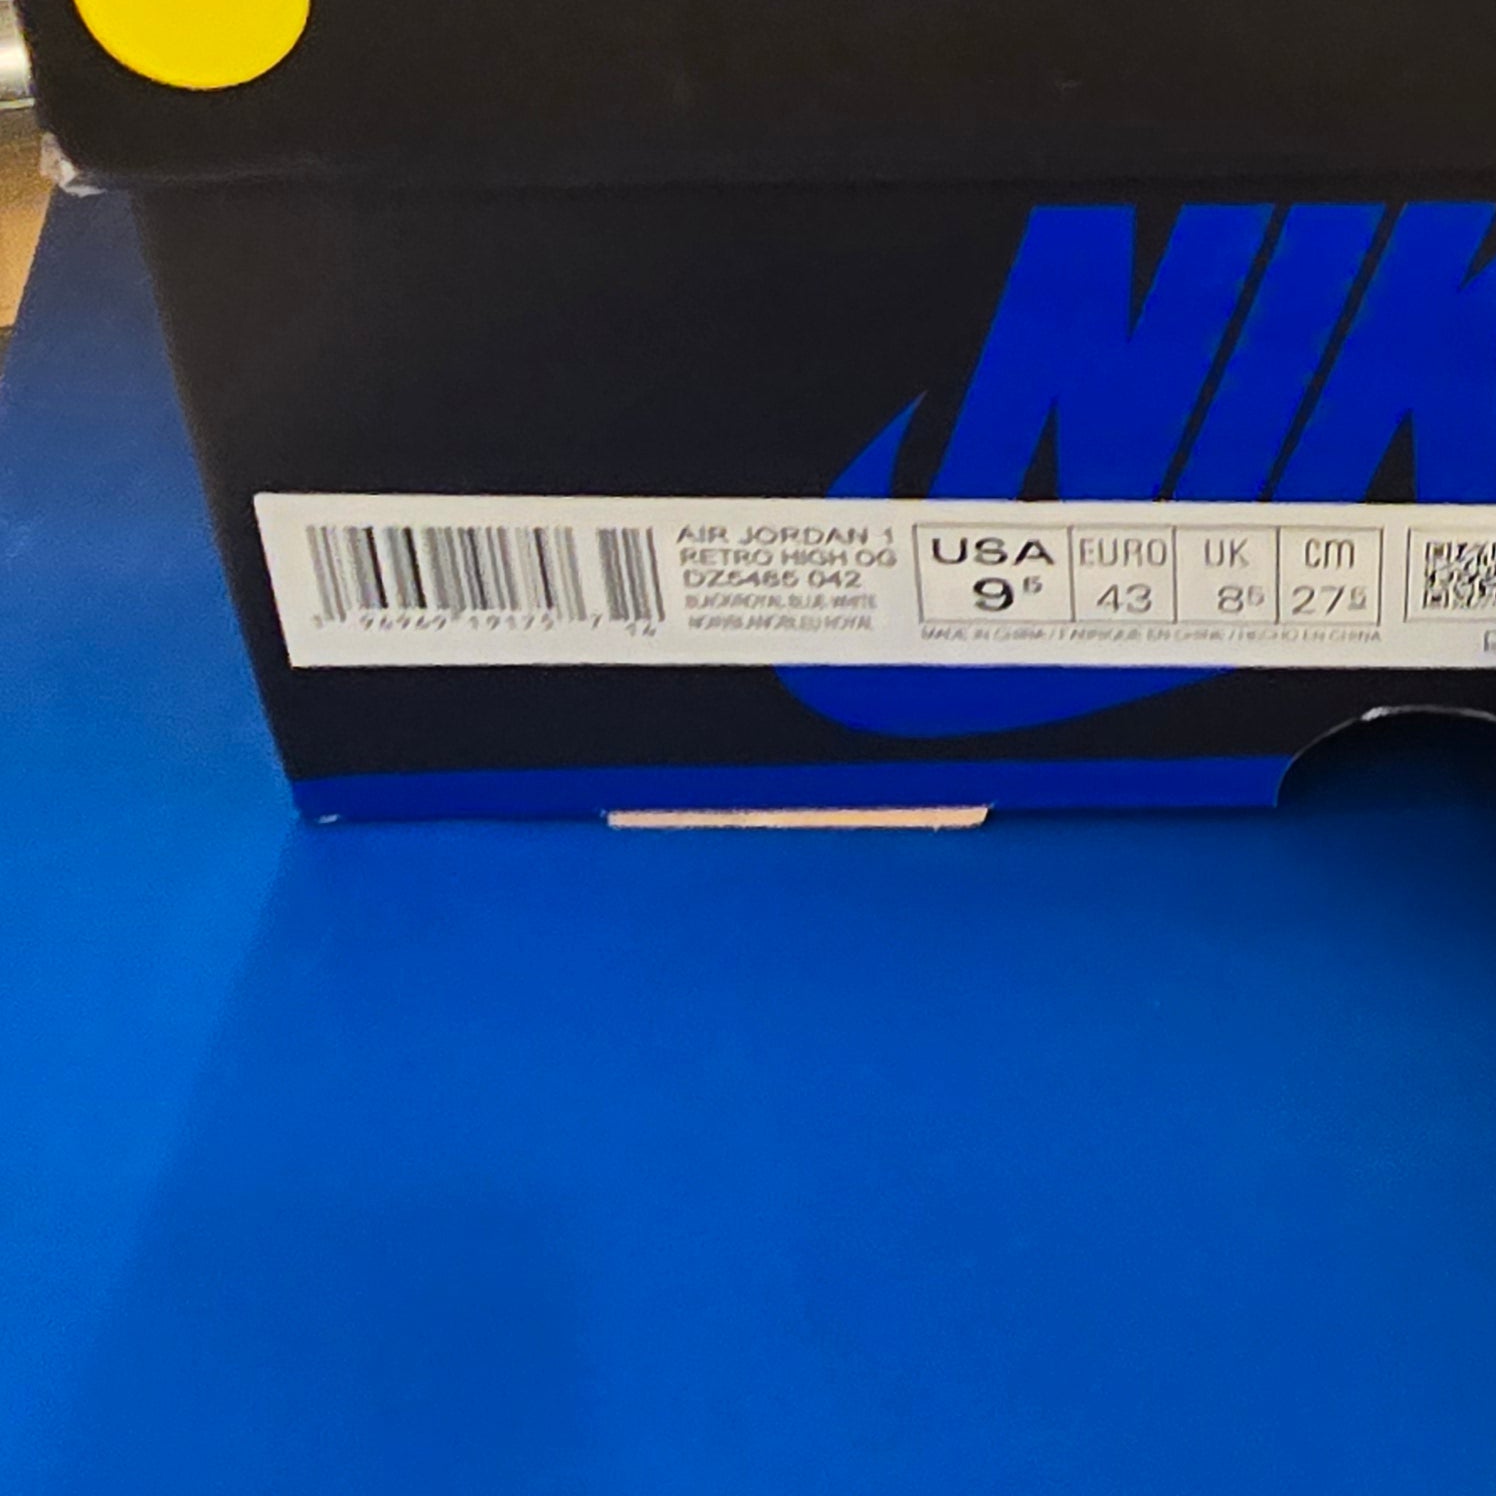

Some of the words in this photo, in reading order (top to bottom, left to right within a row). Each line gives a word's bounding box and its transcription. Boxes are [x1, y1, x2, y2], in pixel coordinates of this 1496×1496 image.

[676, 524, 729, 544] AIR
[738, 525, 868, 546] JORDAN
[884, 527, 894, 545] 1
[680, 547, 773, 566] RETRO
[781, 548, 848, 567] HIGH
[855, 548, 897, 567] OG
[931, 537, 1054, 566] USA
[1079, 538, 1168, 567] EURO
[1204, 538, 1250, 568] UK
[807, 569, 862, 589] 042
[1096, 583, 1152, 614] 43
